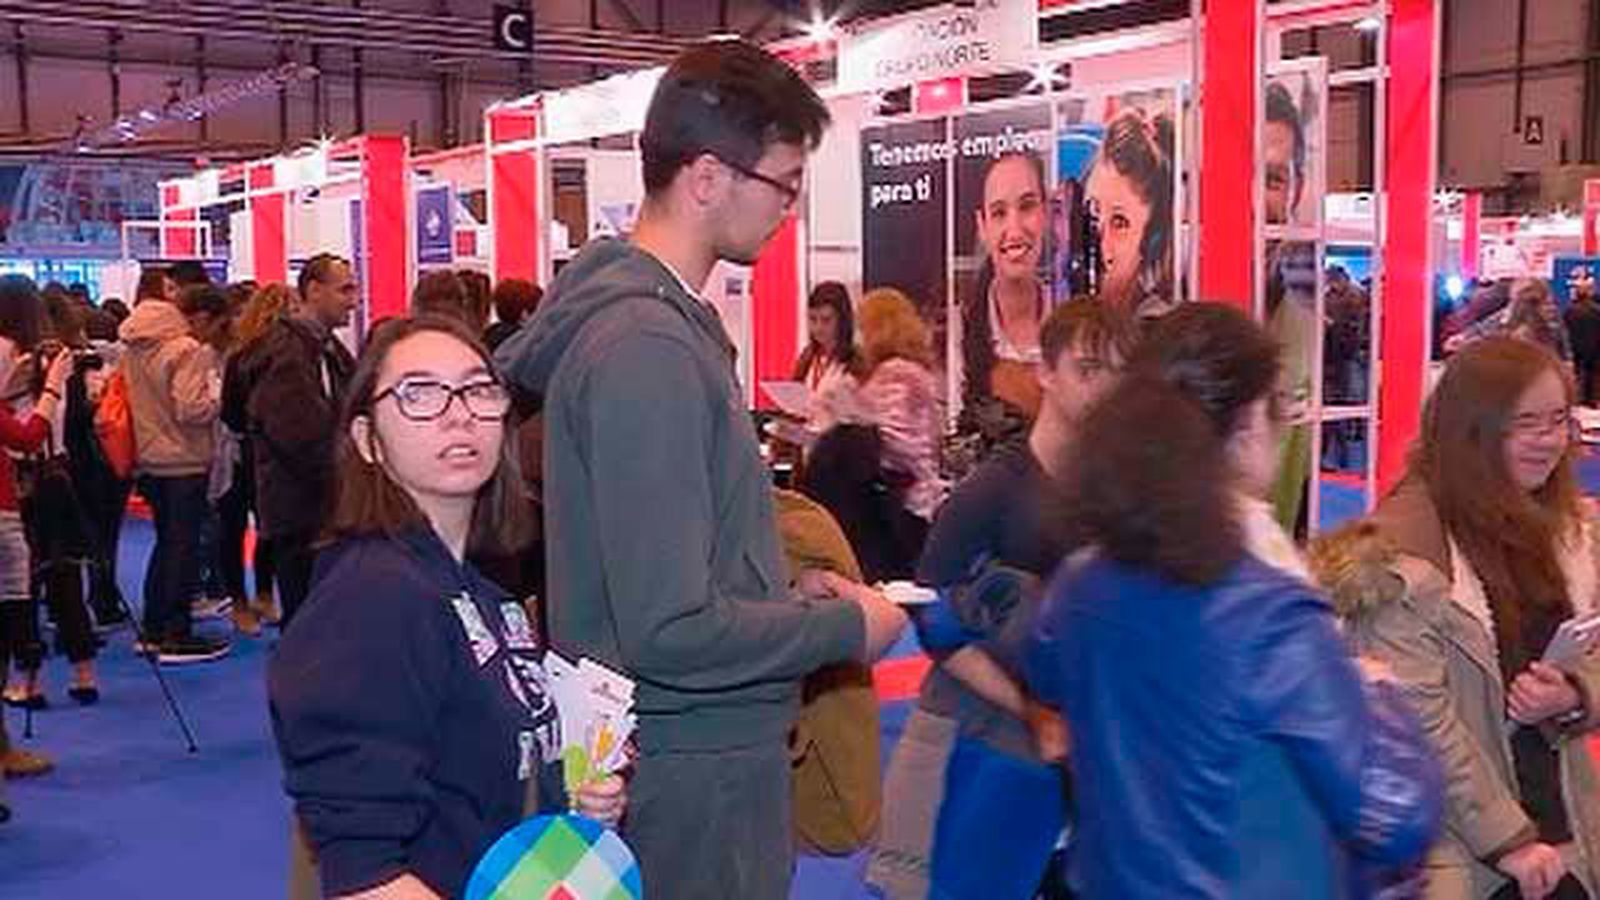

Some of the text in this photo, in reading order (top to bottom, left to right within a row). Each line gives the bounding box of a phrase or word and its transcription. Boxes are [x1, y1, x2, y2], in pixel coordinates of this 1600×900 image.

[502, 13, 525, 48] C
[1527, 120, 1541, 140] A
[870, 174, 931, 208] para ti
